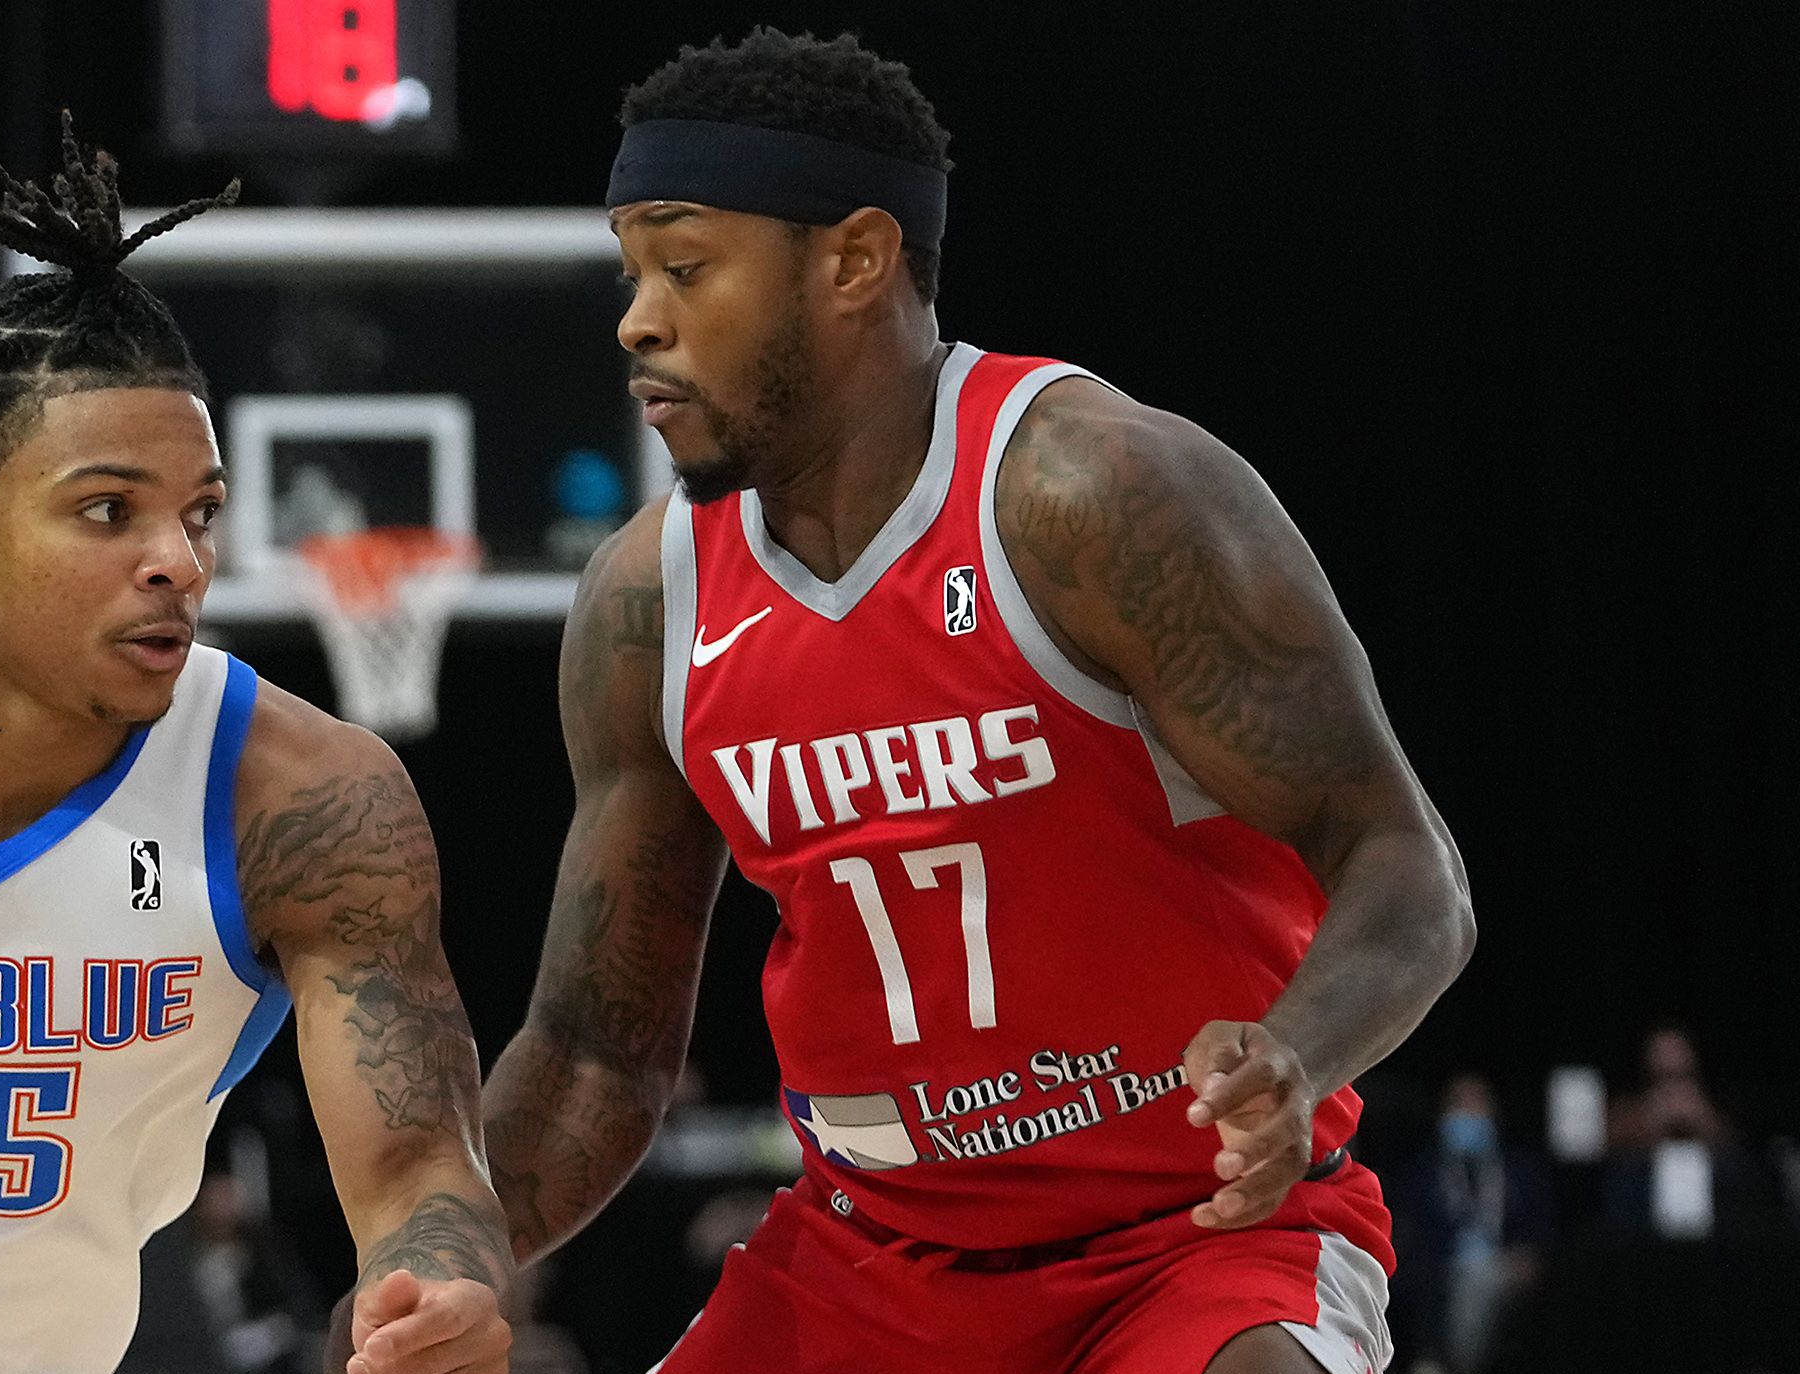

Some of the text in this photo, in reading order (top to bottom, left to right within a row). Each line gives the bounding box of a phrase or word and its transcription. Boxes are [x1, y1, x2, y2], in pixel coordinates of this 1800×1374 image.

[711, 705, 1056, 847] VIPERS
[830, 842, 997, 1045] 17
[909, 1044, 1120, 1123] Lone Star
[923, 1063, 1190, 1162] National Ban
